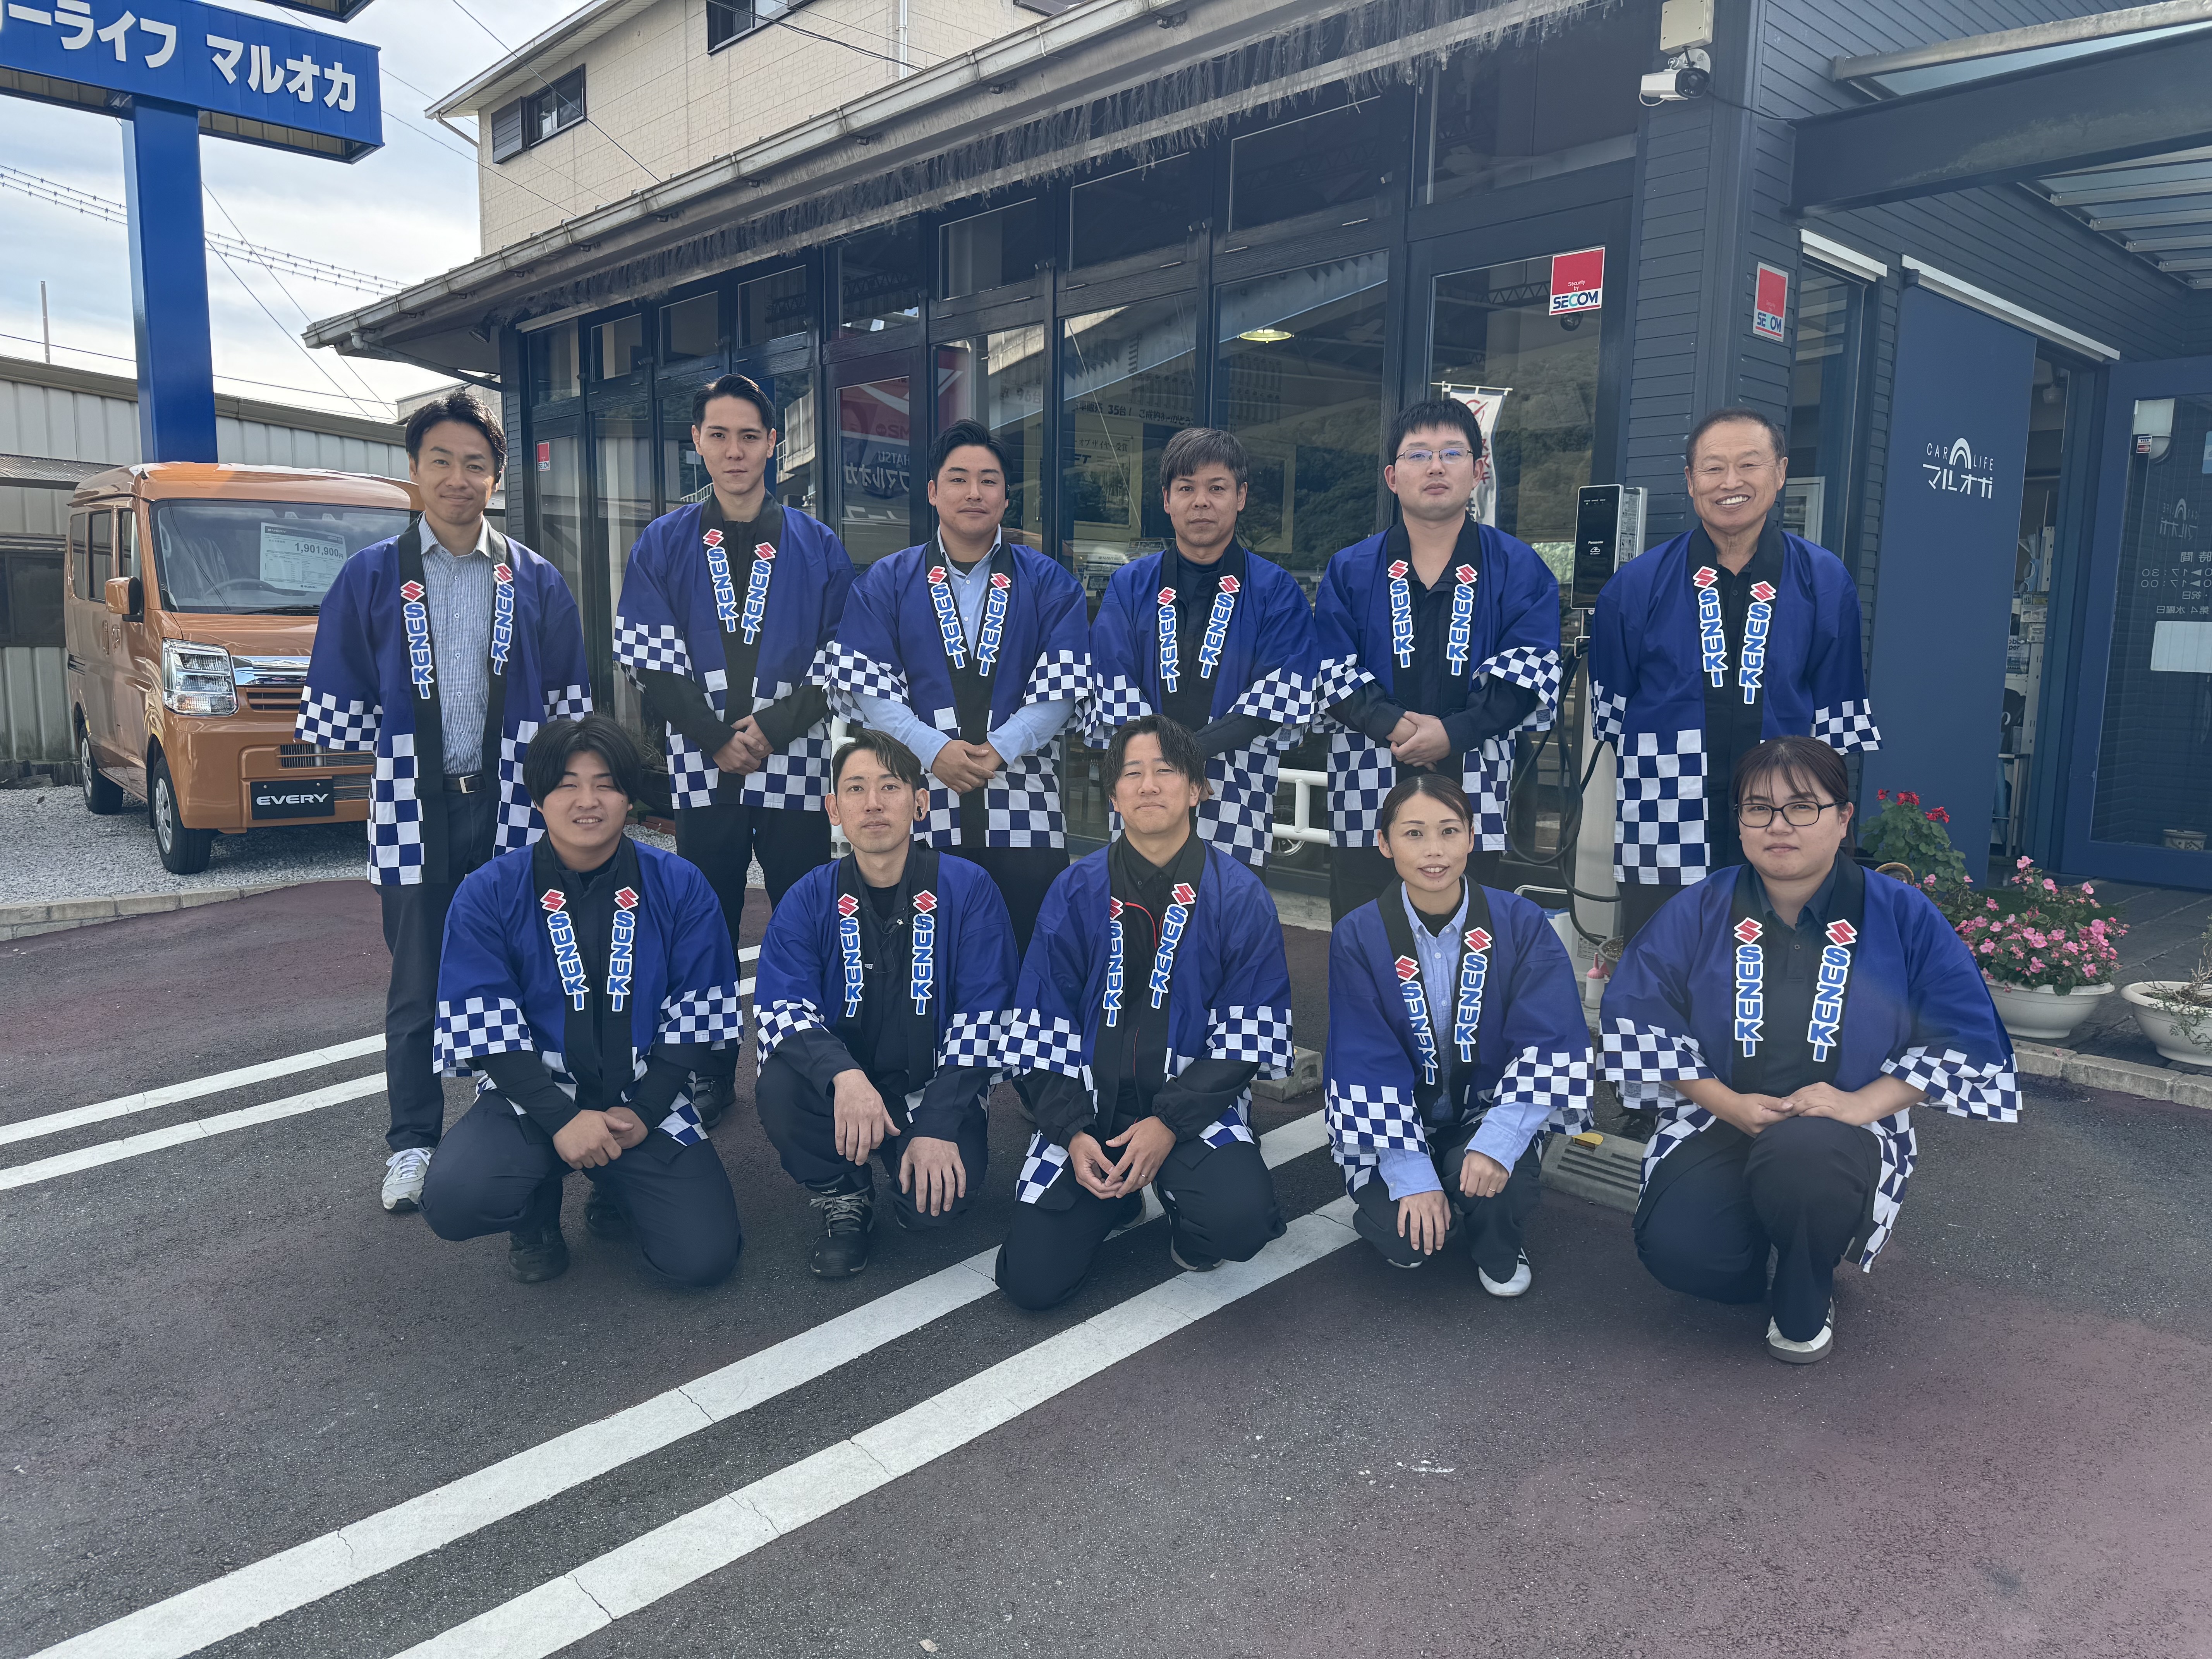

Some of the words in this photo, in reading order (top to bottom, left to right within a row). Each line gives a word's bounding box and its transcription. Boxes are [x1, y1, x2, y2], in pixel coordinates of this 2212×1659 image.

[0, 0, 177, 68] ーライフ
[206, 34, 356, 112] マルオカ
[1553, 290, 1598, 309] SECOM
[1922, 464, 1993, 499] マルオカ
[1927, 443, 1948, 460] CAR
[1973, 454, 1994, 471] LIFE
[295, 543, 343, 560] 1,901,900円
[707, 546, 739, 633] SUZUKI
[491, 581, 515, 675] SUZUKI
[741, 559, 771, 645] SUZUKI
[931, 582, 967, 669] SUZUKI
[977, 587, 1008, 677] SUZUKI
[1198, 592, 1235, 679] SUZUKI
[1389, 578, 1415, 668] SUZUKI
[1446, 584, 1474, 676] SUZUKI
[1698, 587, 1729, 688] SUZUKI
[404, 602, 434, 699] SUZUKI
[1158, 605, 1181, 693] SUZUKI
[1738, 602, 1772, 704] SUZUKI
[256, 793, 329, 805] EVERY
[547, 910, 590, 1011] SUZUKI
[606, 909, 635, 1012] SUZUKI
[840, 917, 864, 1018] SUZUKI
[910, 913, 935, 1015] SUZUKI
[1149, 903, 1188, 1009] SUZUKI
[1734, 944, 1764, 1058] SUZUKI
[1454, 952, 1487, 1062] SUZUKI
[1807, 945, 1851, 1062] SUZUKI
